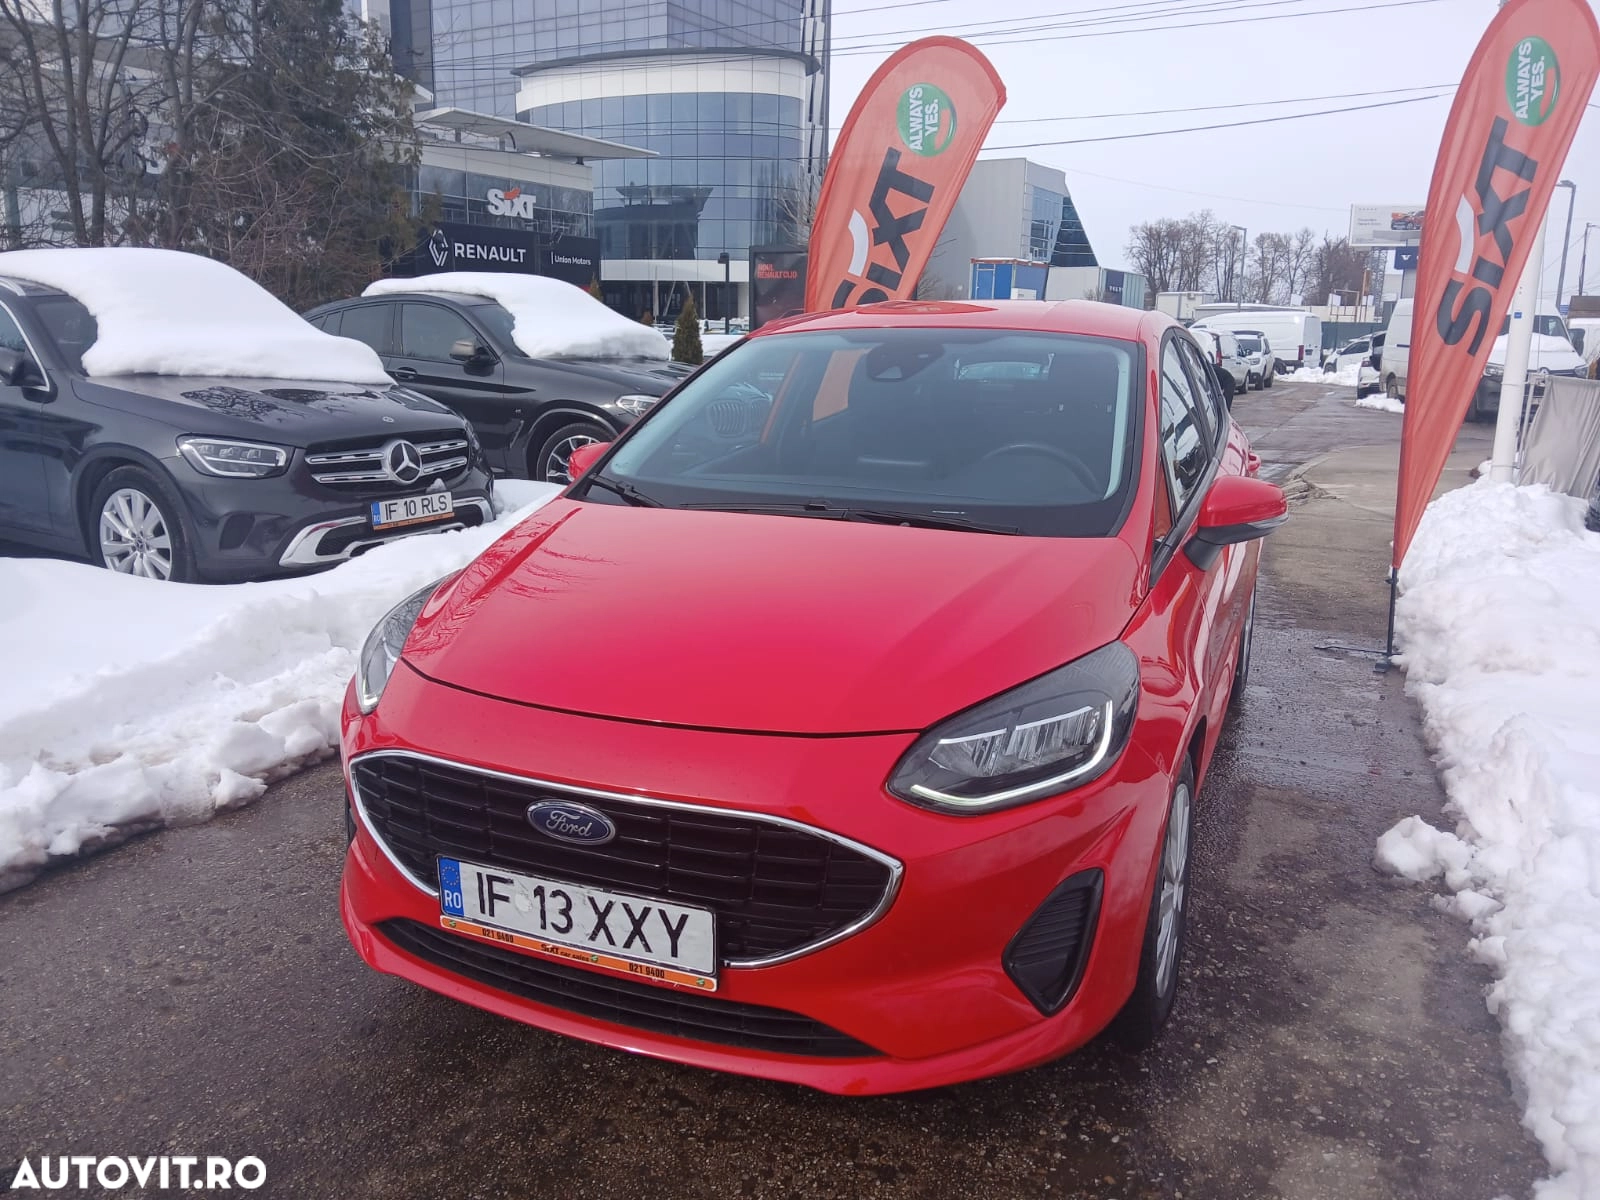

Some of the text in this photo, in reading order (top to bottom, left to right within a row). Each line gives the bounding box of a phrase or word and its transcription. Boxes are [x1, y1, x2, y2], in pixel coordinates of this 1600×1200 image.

[1515, 41, 1532, 119] ALWAYS
[1530, 56, 1545, 102] YES.
[908, 87, 924, 151] ALWAYS
[924, 98, 939, 136] YES.
[454, 241, 526, 263] RENAULT
[554, 255, 591, 265] Union Motors
[385, 495, 447, 520] IF 10 RLS
[546, 810, 592, 837] Ford
[444, 889, 462, 909] RO
[476, 871, 689, 958] IF 13 XXY
[482, 927, 495, 939] 021
[629, 962, 665, 979] 021 9400
